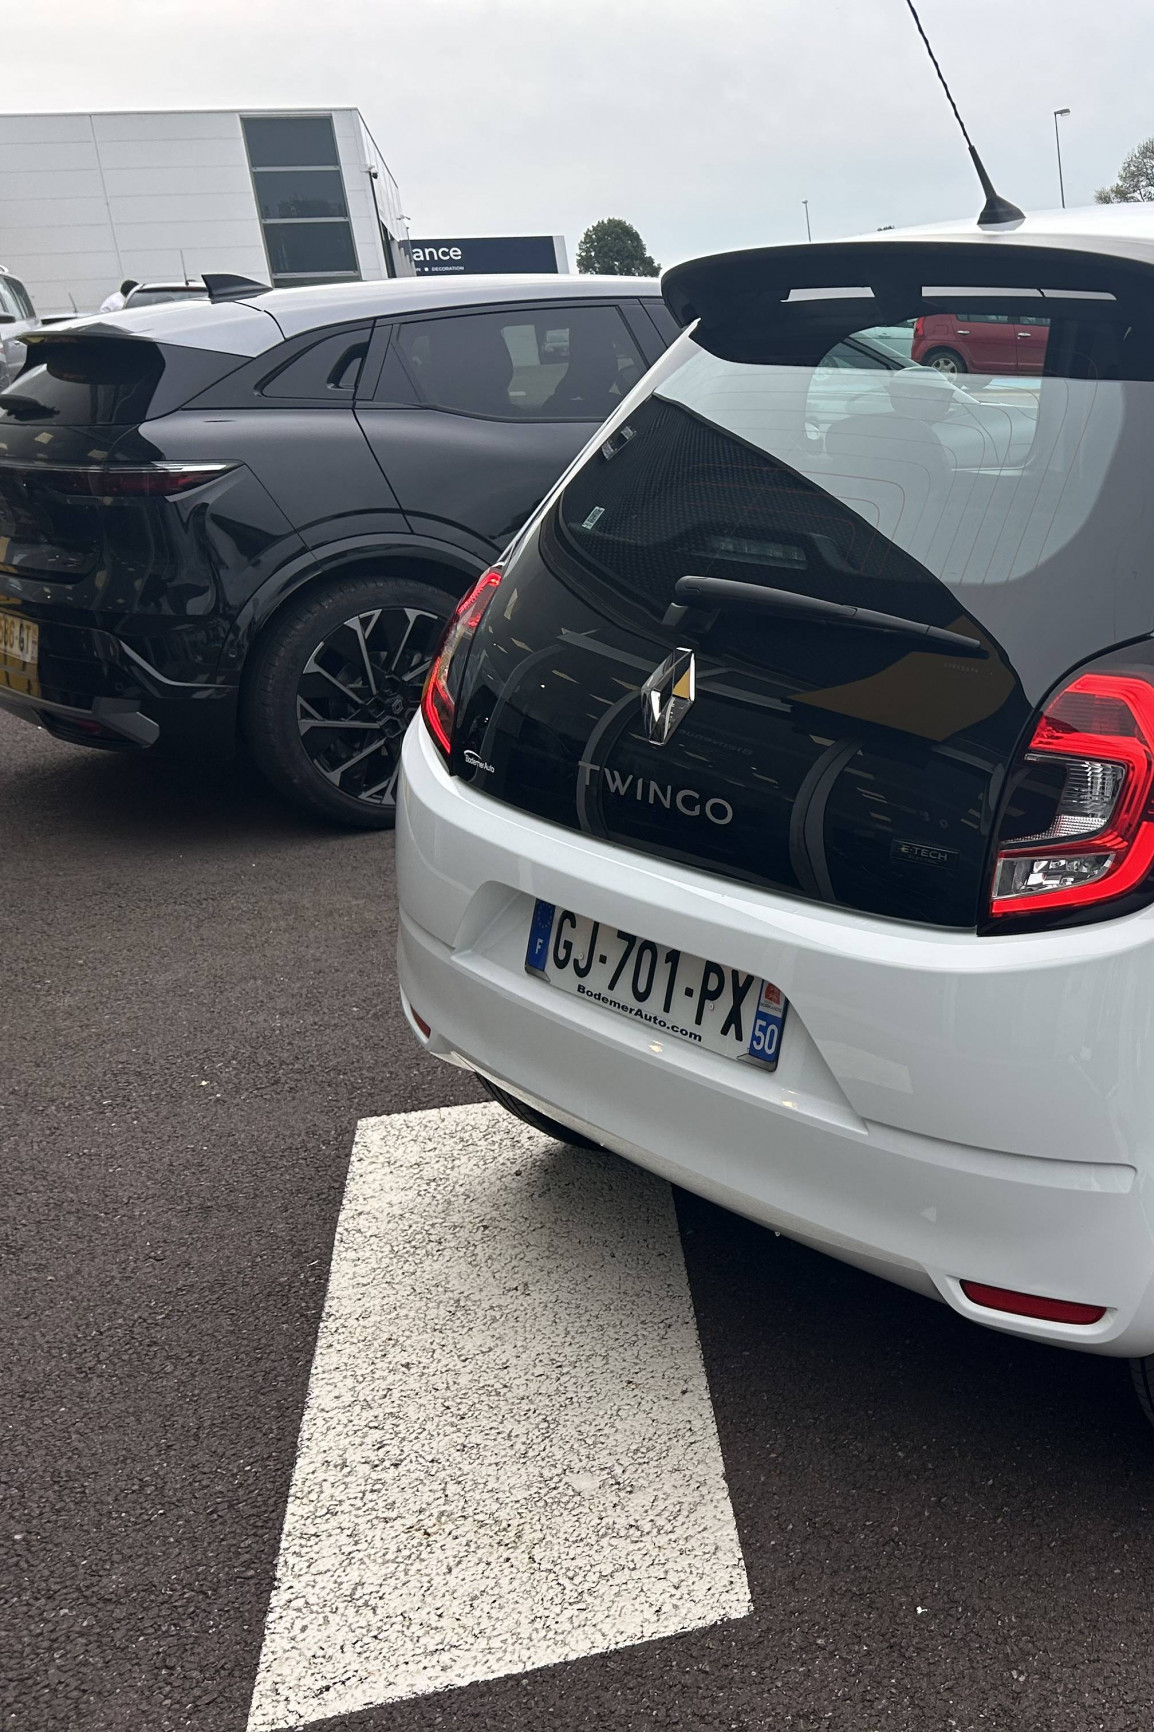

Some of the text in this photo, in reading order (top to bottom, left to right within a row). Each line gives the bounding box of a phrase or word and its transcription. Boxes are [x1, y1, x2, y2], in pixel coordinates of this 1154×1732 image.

[412, 246, 462, 262] ance
[578, 760, 733, 825] TWINGO
[901, 844, 948, 861] E-TECH
[534, 909, 779, 1055] F GJ-701-PX 50
[577, 983, 703, 1043] BodemerAuto.com
